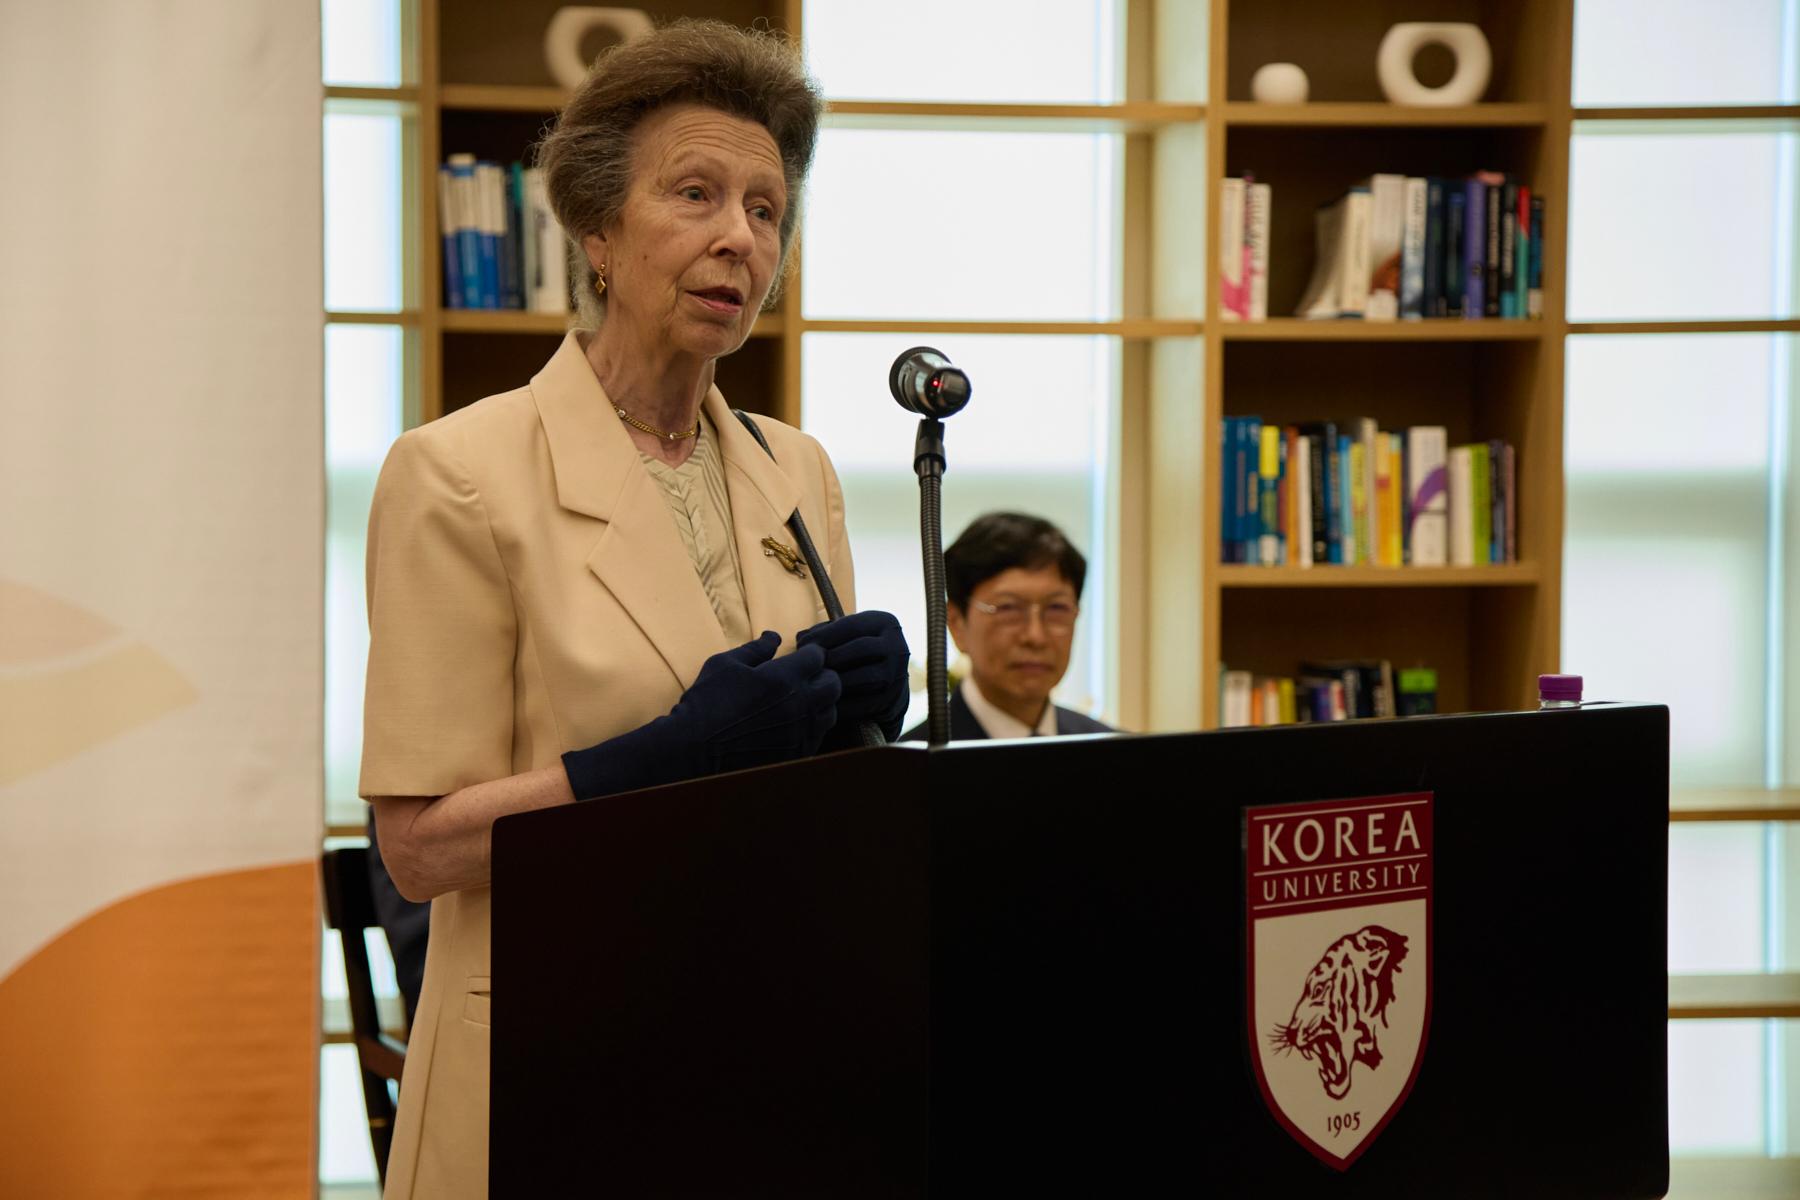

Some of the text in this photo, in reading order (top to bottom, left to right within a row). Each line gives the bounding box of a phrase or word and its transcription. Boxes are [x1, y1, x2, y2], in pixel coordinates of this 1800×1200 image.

[1263, 810, 1421, 866] KOREA
[1263, 863, 1421, 900] UNIVERSITY
[1327, 1111, 1361, 1138] 1905
